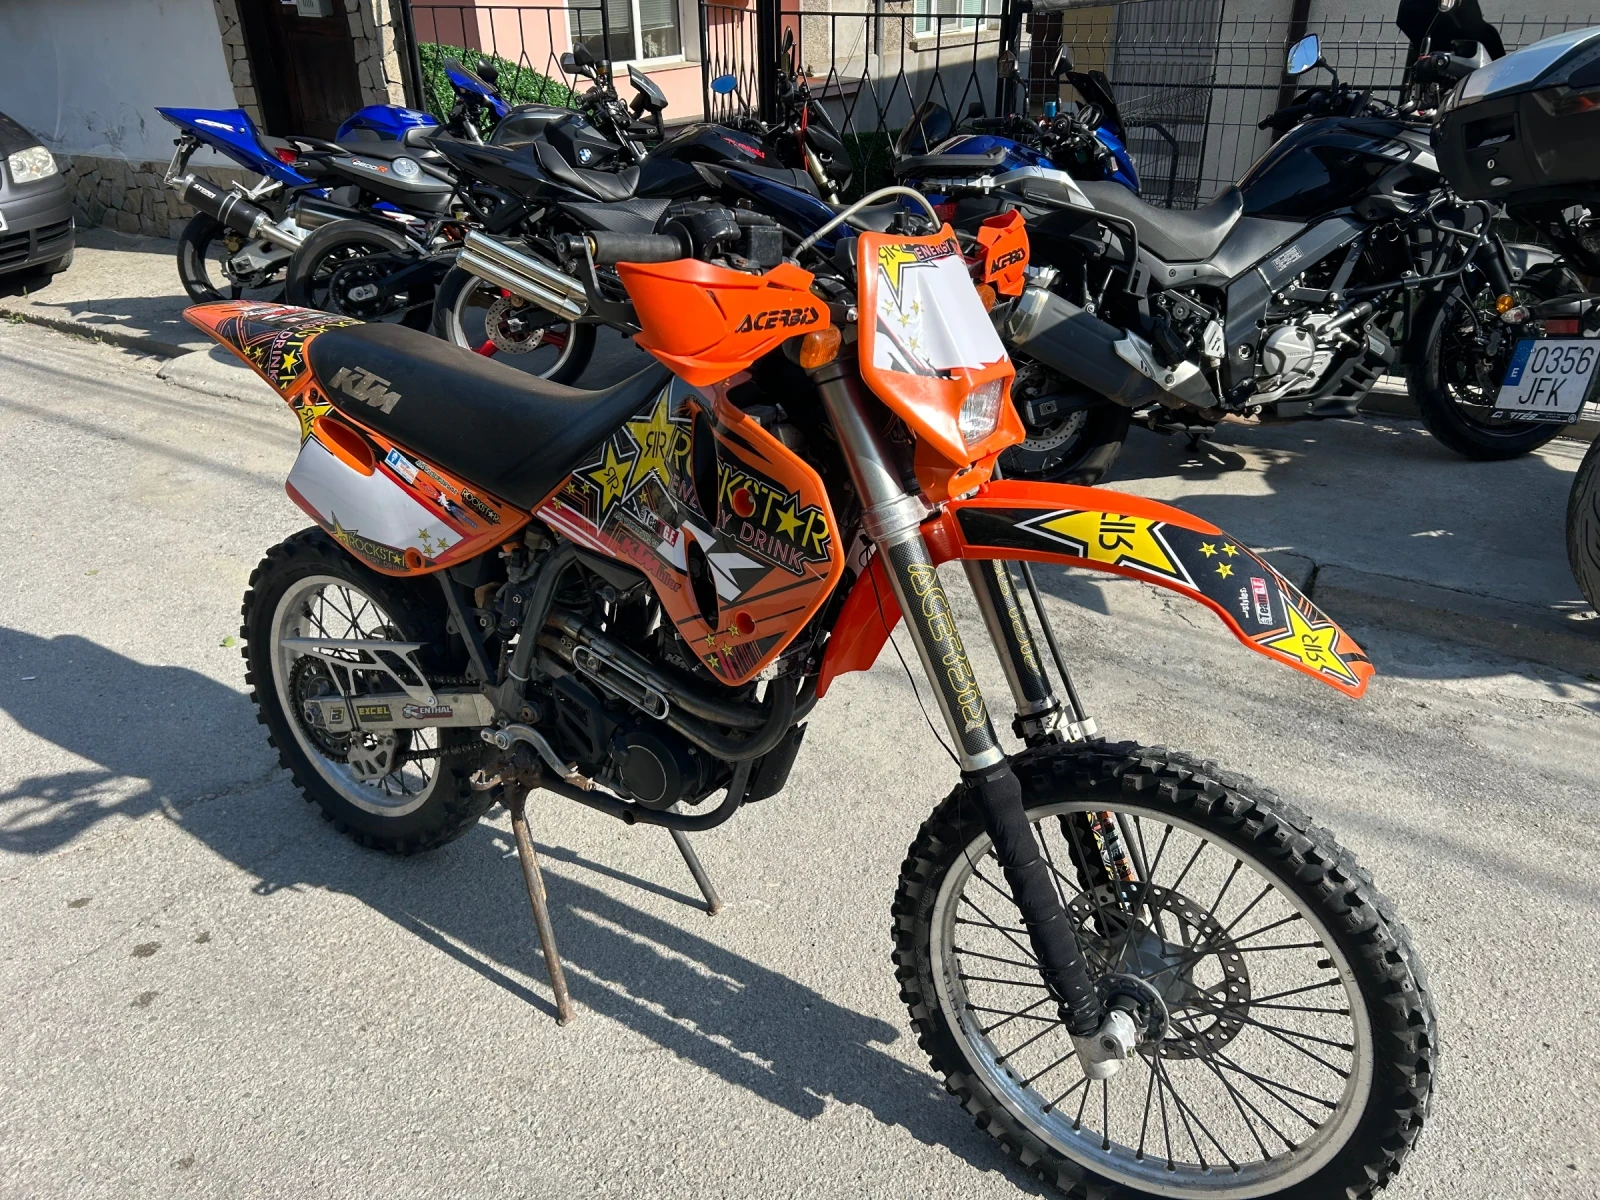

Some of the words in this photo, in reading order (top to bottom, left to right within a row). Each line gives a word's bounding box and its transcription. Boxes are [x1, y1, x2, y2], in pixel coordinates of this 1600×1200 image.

[734, 306, 820, 333] ACERBIS
[1510, 367, 1520, 378] E
[1530, 346, 1595, 375] 0356
[328, 366, 402, 415] KTM
[1518, 377, 1568, 406] JFK
[739, 522, 805, 570] DRINK
[358, 706, 390, 716] EXCEL
